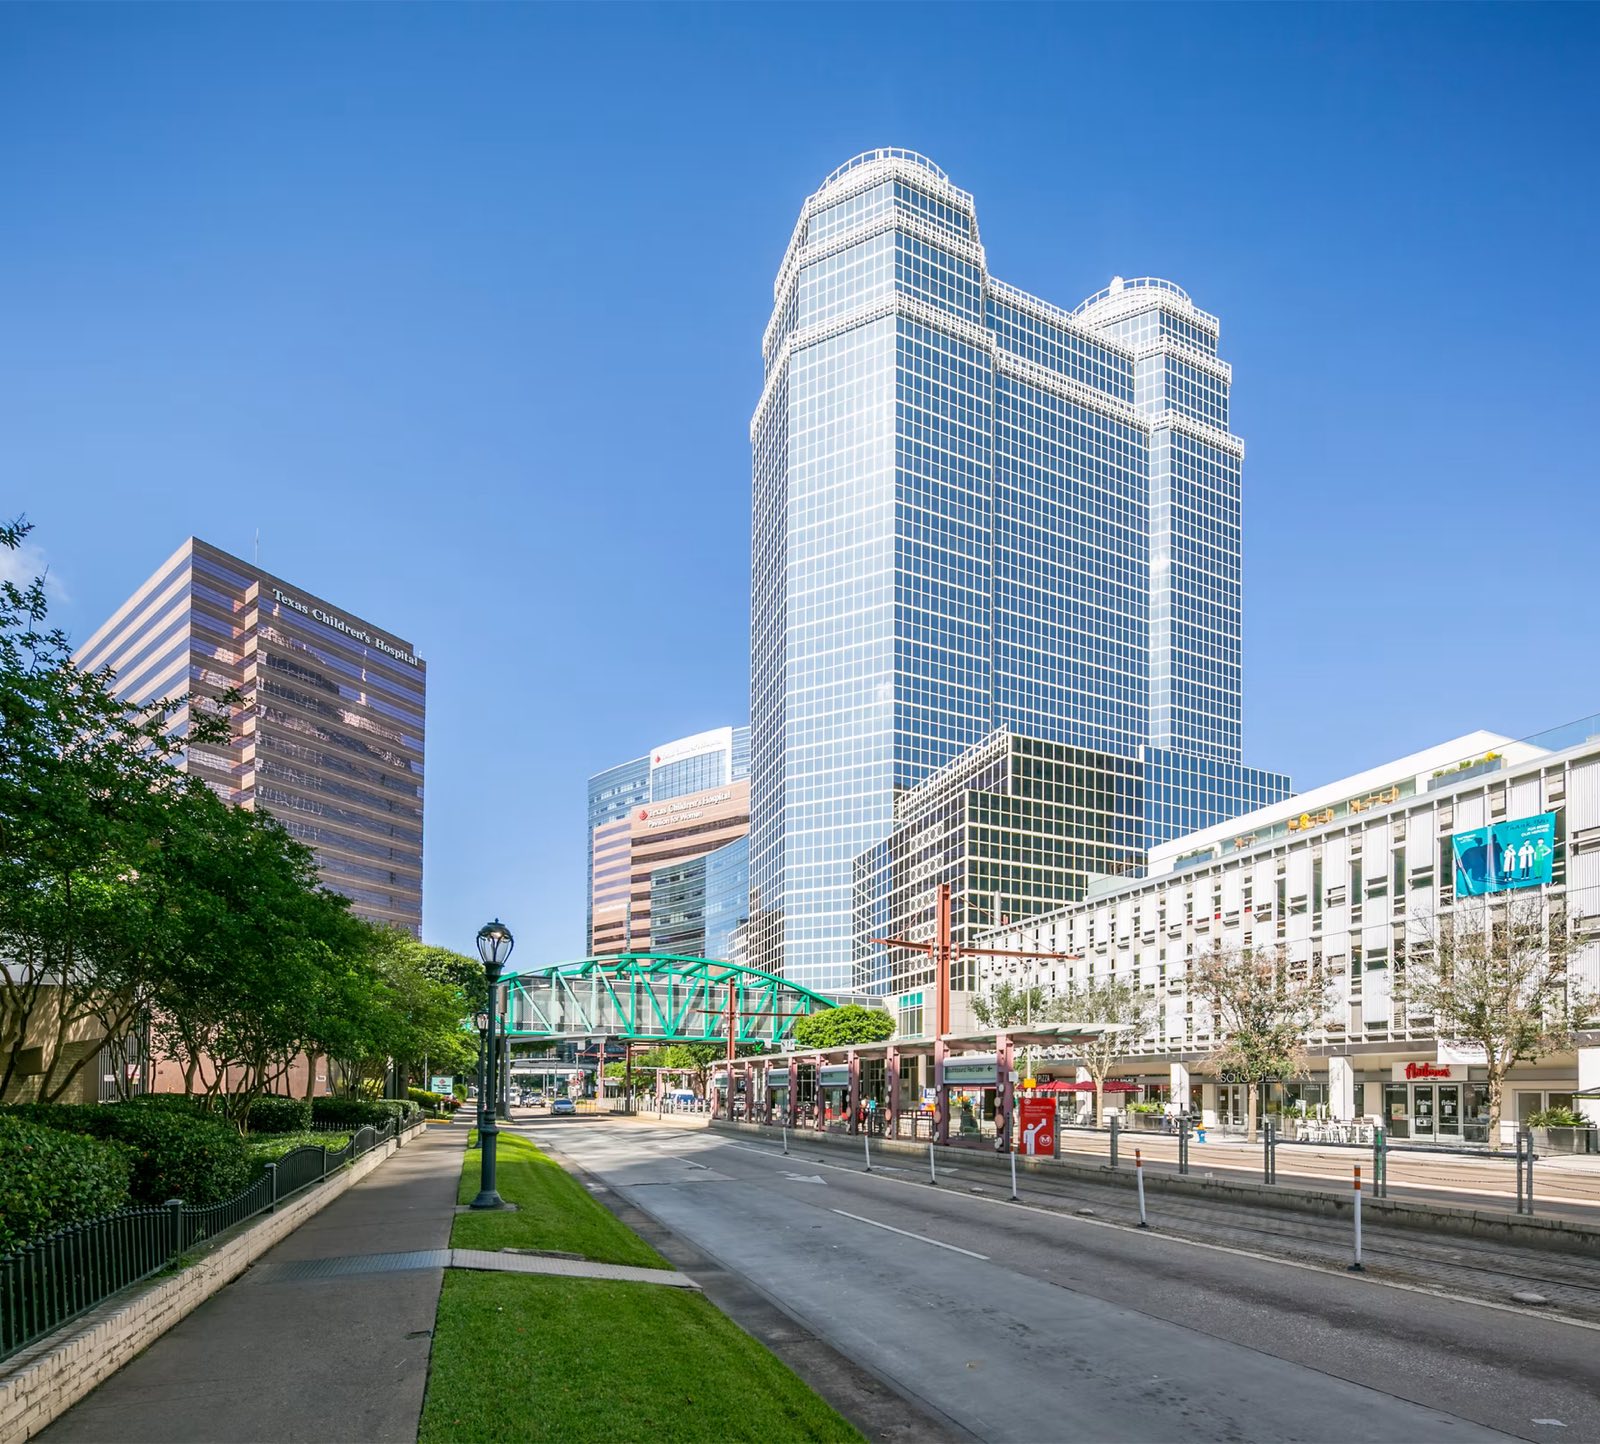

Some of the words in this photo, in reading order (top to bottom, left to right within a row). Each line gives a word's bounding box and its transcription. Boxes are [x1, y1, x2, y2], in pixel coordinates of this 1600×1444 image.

[272, 588, 308, 614] Texas
[312, 608, 371, 644] Children's
[375, 638, 418, 666] Hospital
[648, 808, 668, 818] Texas
[702, 790, 731, 805] Hospital
[1036, 1074, 1051, 1083] PIZZA
[1220, 1072, 1265, 1083] salaa
